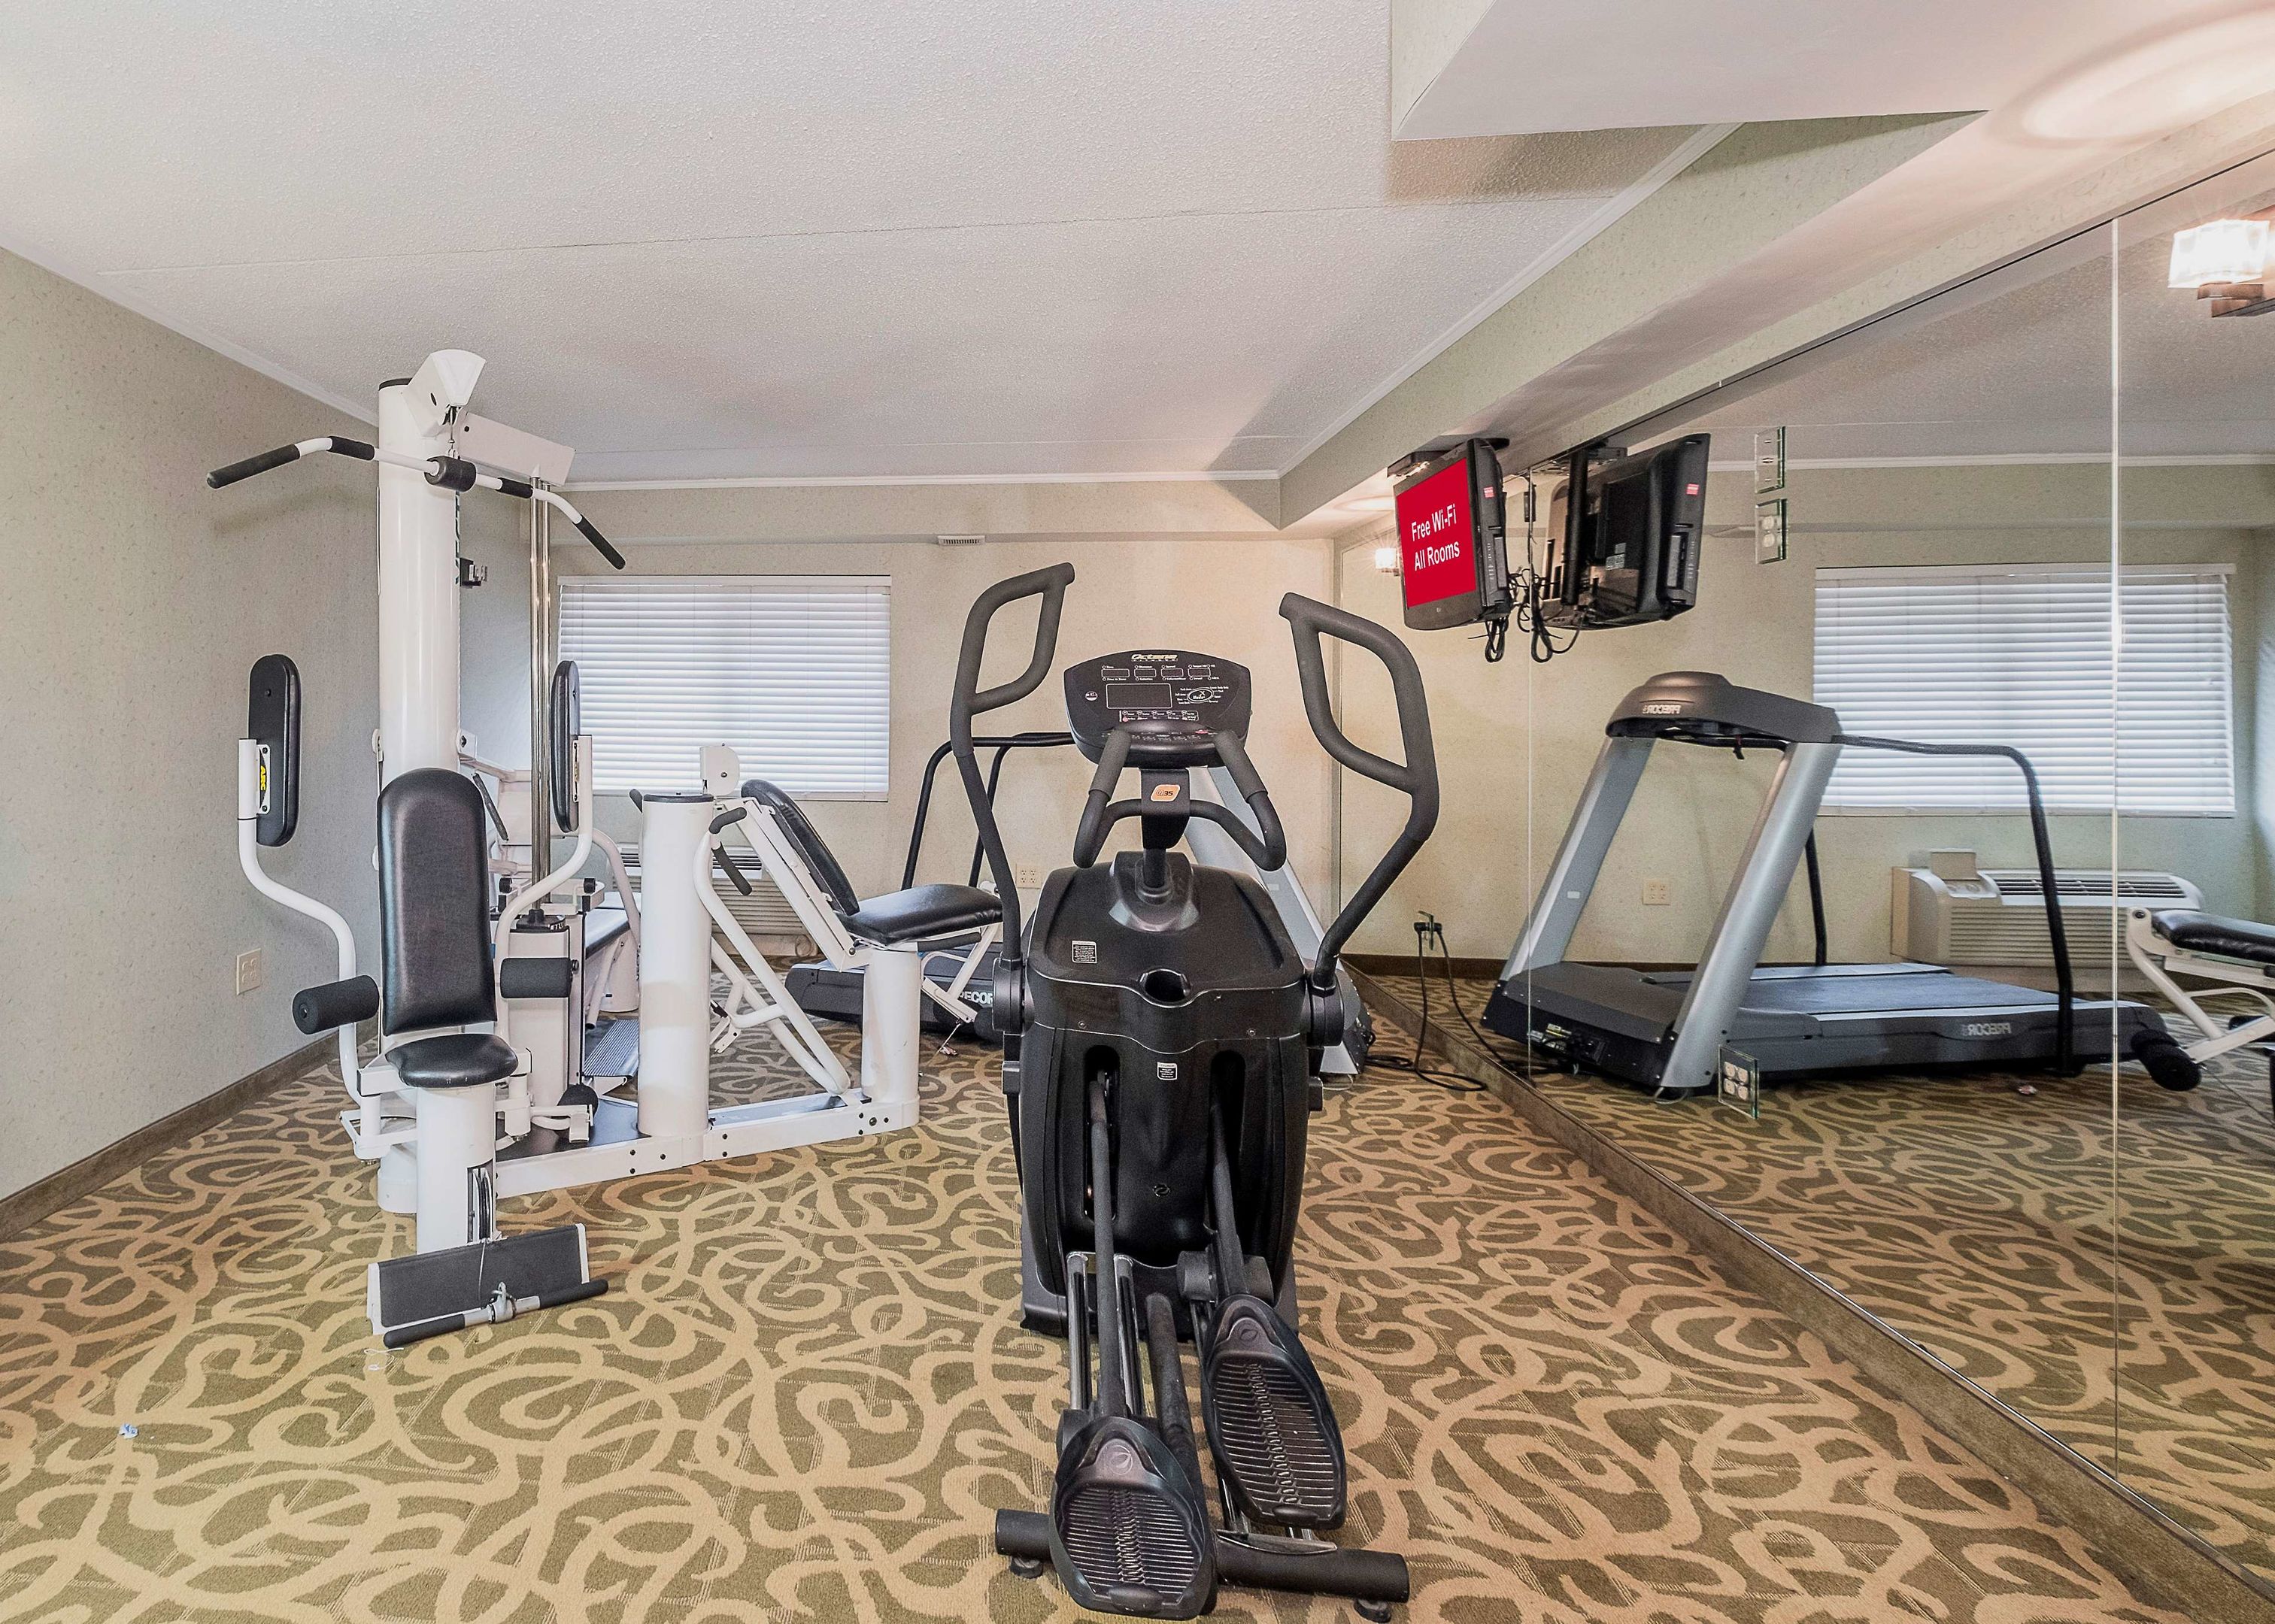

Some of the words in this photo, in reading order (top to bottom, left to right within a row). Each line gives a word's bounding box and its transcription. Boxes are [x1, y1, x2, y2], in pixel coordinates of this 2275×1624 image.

[1411, 521, 1431, 541] Free
[1431, 503, 1457, 532] Wi-Fi
[1415, 549, 1426, 571] All
[1427, 541, 1461, 567] Rooms
[962, 991, 993, 1004] ECOR
